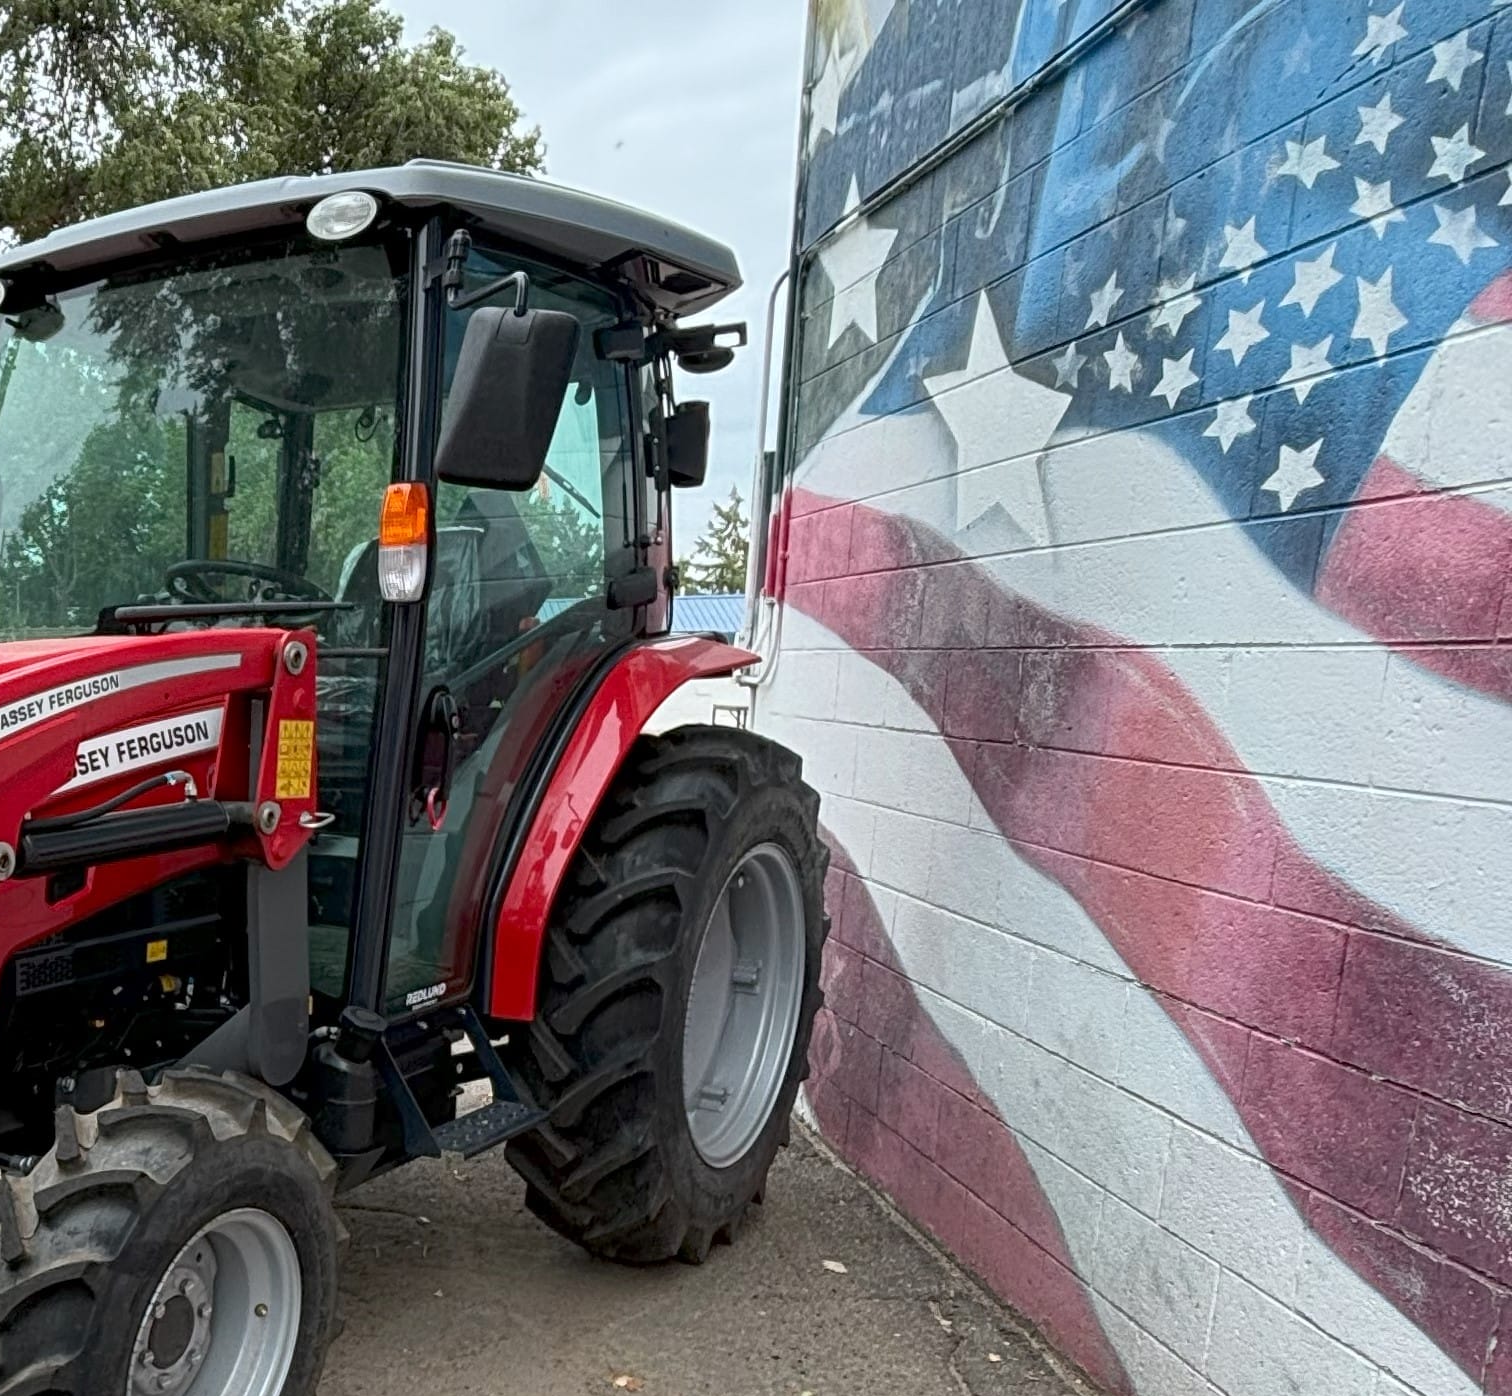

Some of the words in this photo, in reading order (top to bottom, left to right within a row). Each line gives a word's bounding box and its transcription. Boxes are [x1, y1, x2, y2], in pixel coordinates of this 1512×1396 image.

[48, 674, 120, 710] FERGUSON
[72, 746, 110, 776] SEY
[115, 720, 210, 763] FERGUSON
